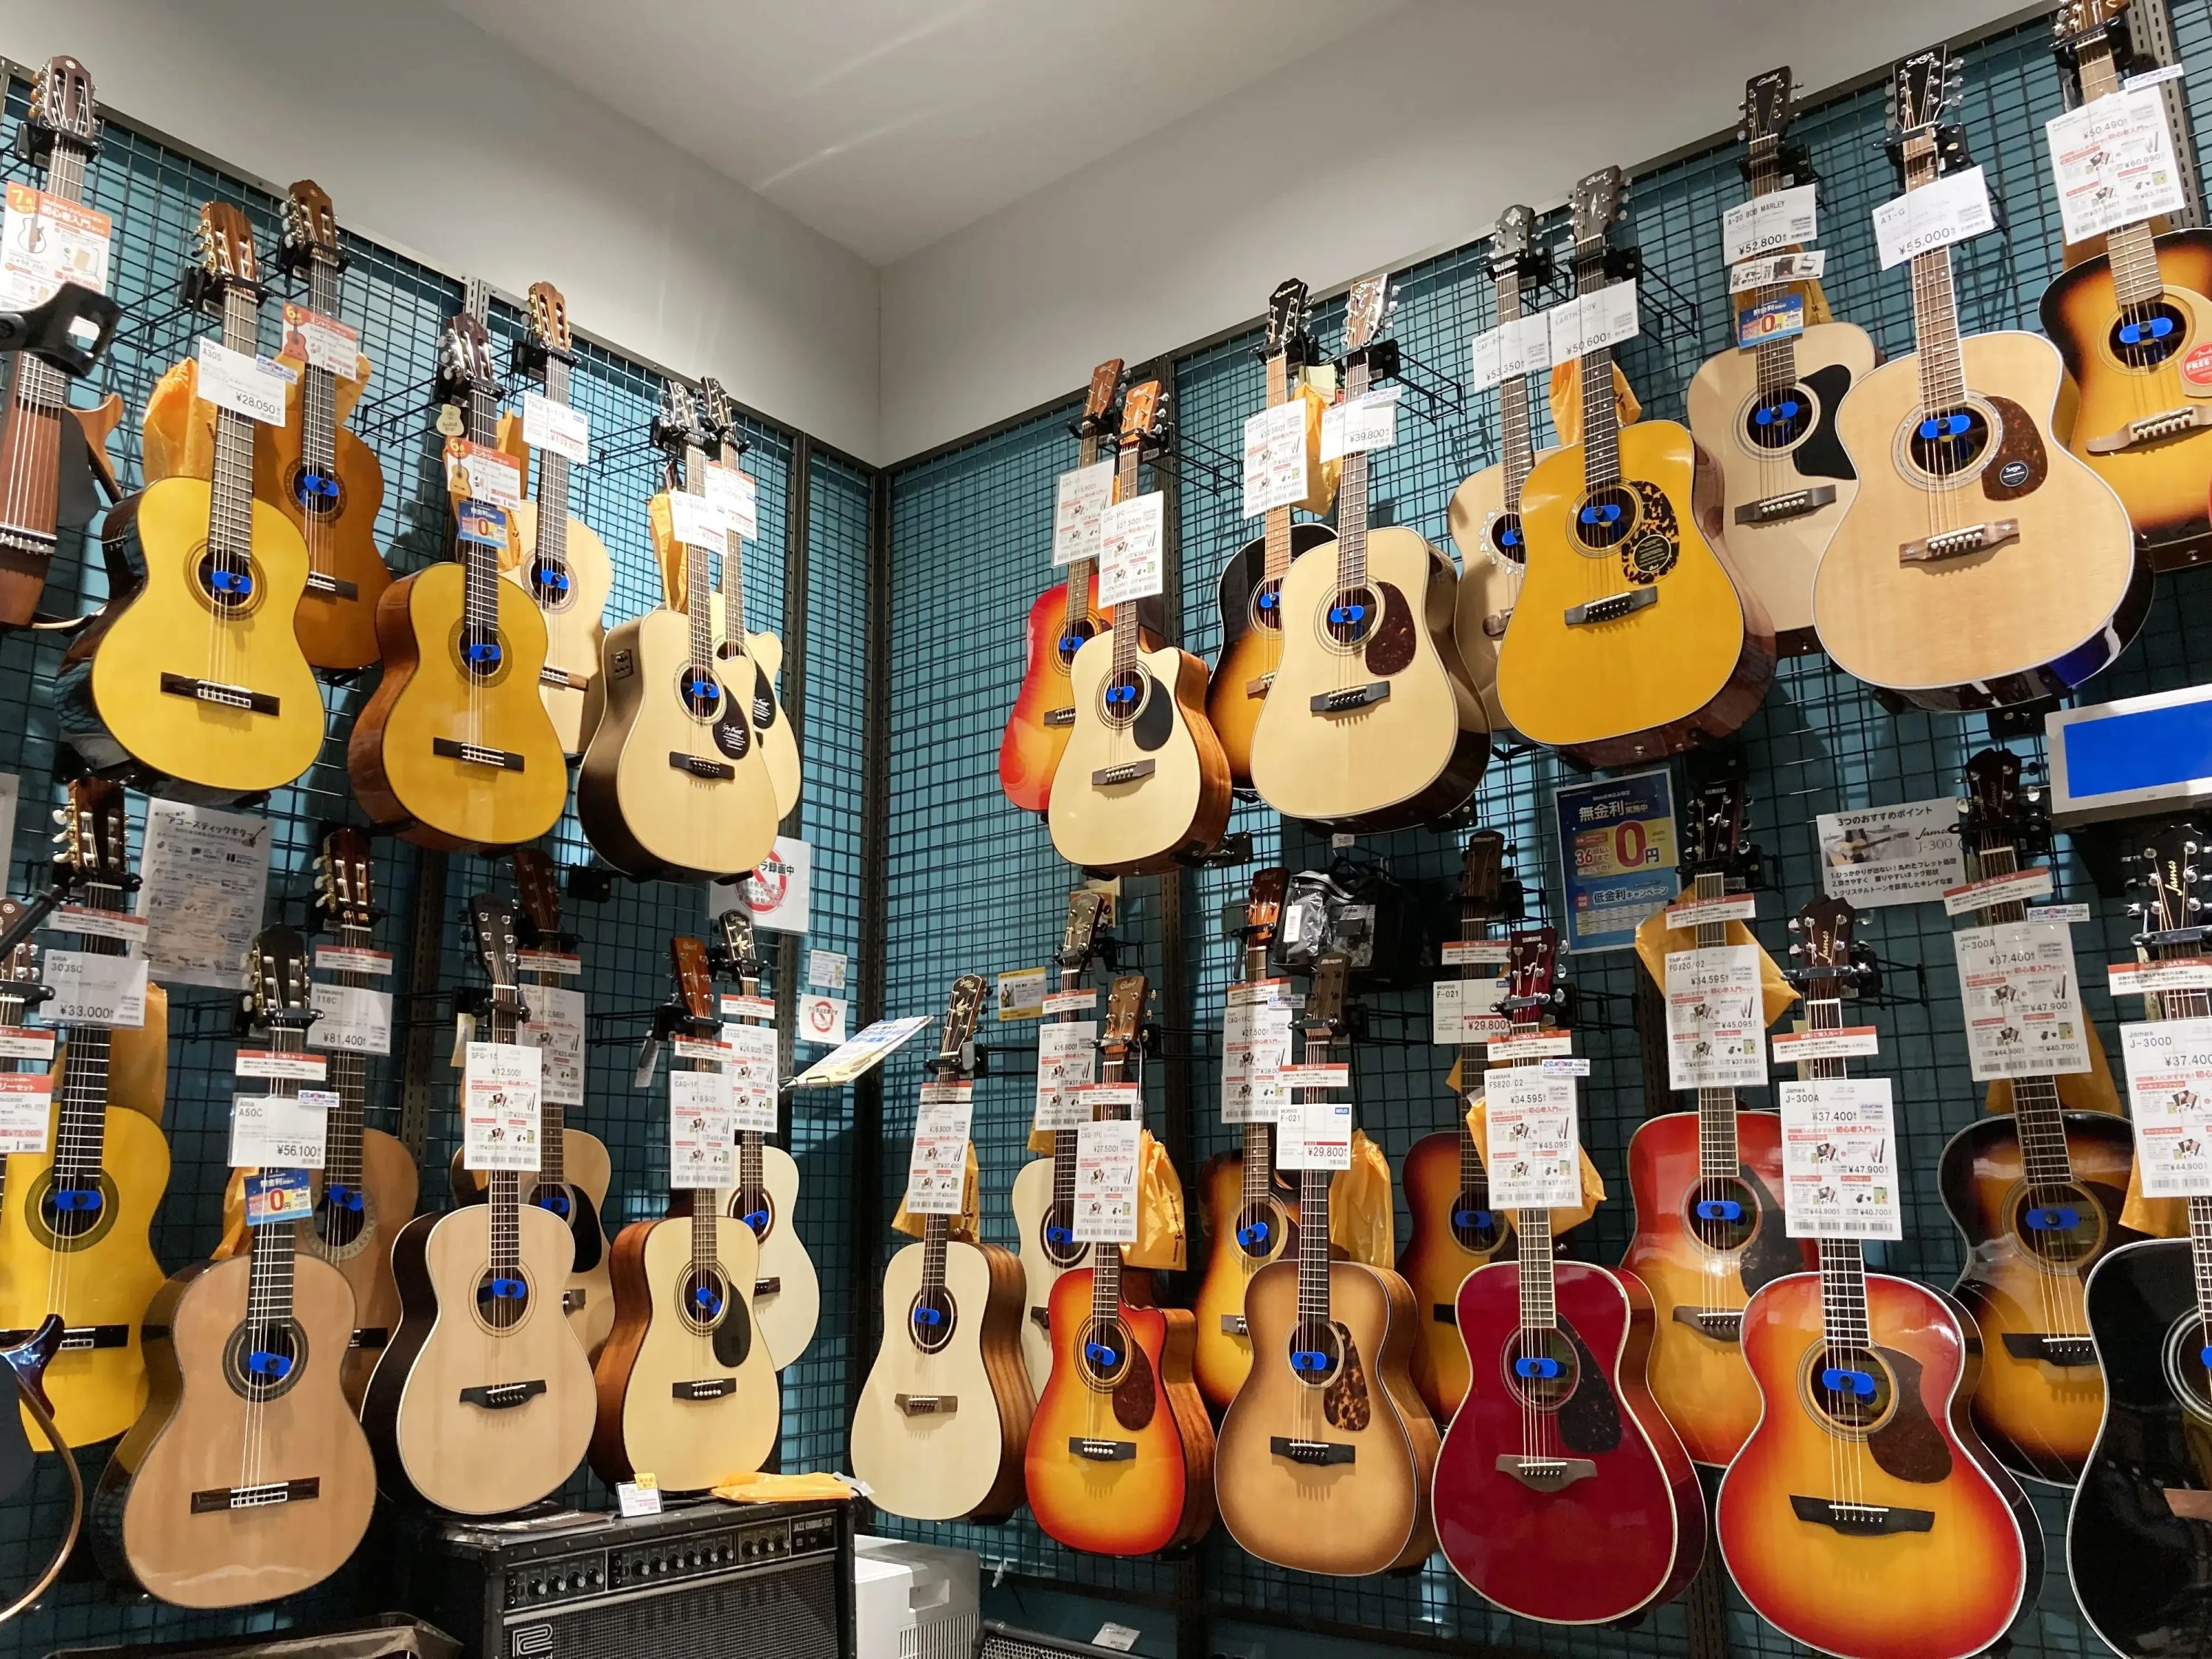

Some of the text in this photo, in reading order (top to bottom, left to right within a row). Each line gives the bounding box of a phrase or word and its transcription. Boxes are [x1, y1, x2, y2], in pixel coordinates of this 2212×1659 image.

[1906, 52, 1934, 67] Saga
[1761, 201, 1785, 215] MARLEY
[1739, 234, 1781, 256] ¥52,800
[1899, 228, 1942, 256] ¥55,000
[1566, 333, 1606, 355] ¥50,600
[1486, 361, 1520, 380] ¥53,350
[236, 392, 275, 415] ¥28,050
[1349, 429, 1385, 444] ¥39,800
[1579, 799, 1625, 823] 無金利
[1837, 806, 1933, 827] 3つのおすすめポイント
[1615, 820, 1659, 868] 0円
[1918, 838, 1952, 853] J-300
[1576, 849, 1593, 865] 36
[757, 861, 795, 875] ラ録画中
[2165, 860, 2183, 896] James
[1818, 931, 1832, 962] James
[1961, 939, 1995, 951] J-300A
[1989, 953, 2031, 965] ¥37,400
[1120, 980, 1136, 990] Cort
[1691, 974, 1725, 984] ¥34,595
[61, 1007, 110, 1020] ¥33,000
[2031, 1002, 2068, 1012] ¥47,900
[1469, 1020, 1506, 1030] ¥29,800
[1722, 1020, 1752, 1029] ¥45,095
[324, 1032, 363, 1046] ¥81,400
[2129, 1030, 2154, 1038] James
[2130, 1037, 2171, 1048] J-300D
[1489, 1079, 1523, 1089] FS820/02
[1511, 1094, 1543, 1104] ¥34,595
[1786, 1094, 1820, 1104] J-300A
[238, 1108, 263, 1118] A50C
[1280, 1114, 1300, 1122] F-021
[1812, 1111, 1853, 1122] ¥37,400
[277, 1145, 317, 1158] ¥56,100
[1308, 1147, 1343, 1157] ¥29,800
[1848, 1166, 1884, 1174] ¥47,900
[793, 1523, 804, 1531] JAZZ
